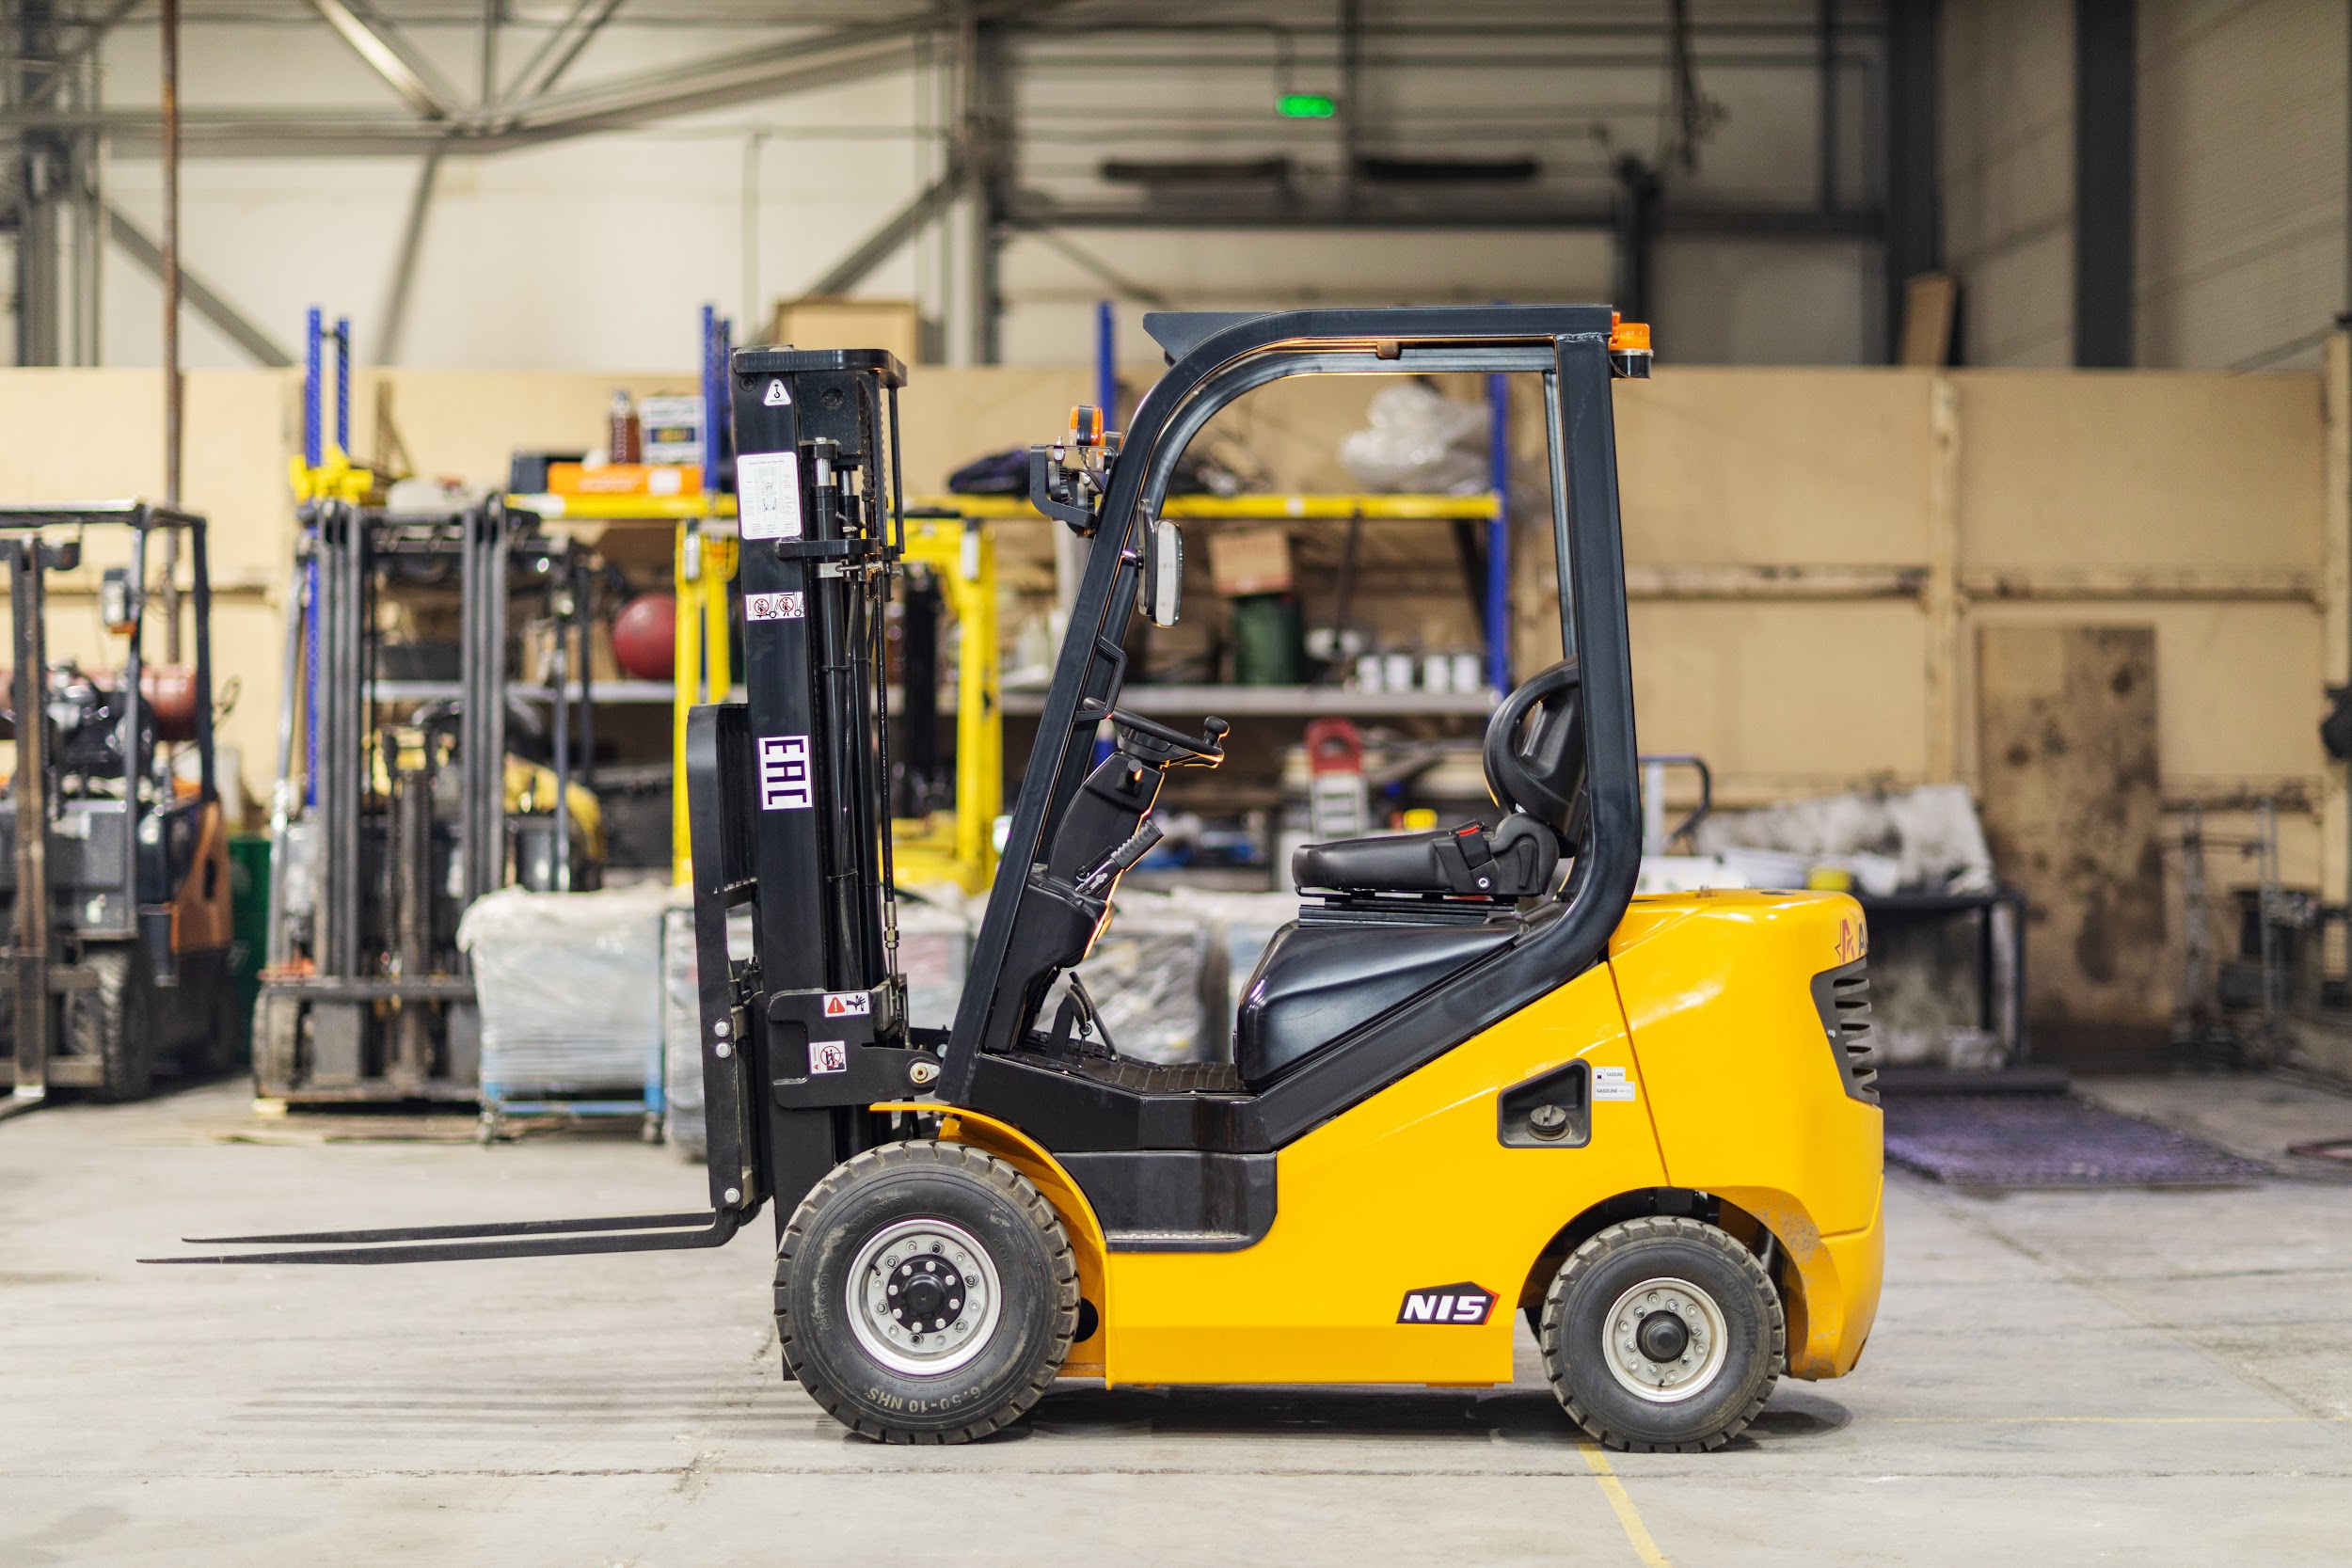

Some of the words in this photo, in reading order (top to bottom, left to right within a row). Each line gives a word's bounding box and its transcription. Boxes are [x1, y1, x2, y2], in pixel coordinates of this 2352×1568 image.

[765, 739, 807, 805] EAC
[867, 1387, 903, 1410] NHS
[909, 1386, 980, 1413] 6.50-10
